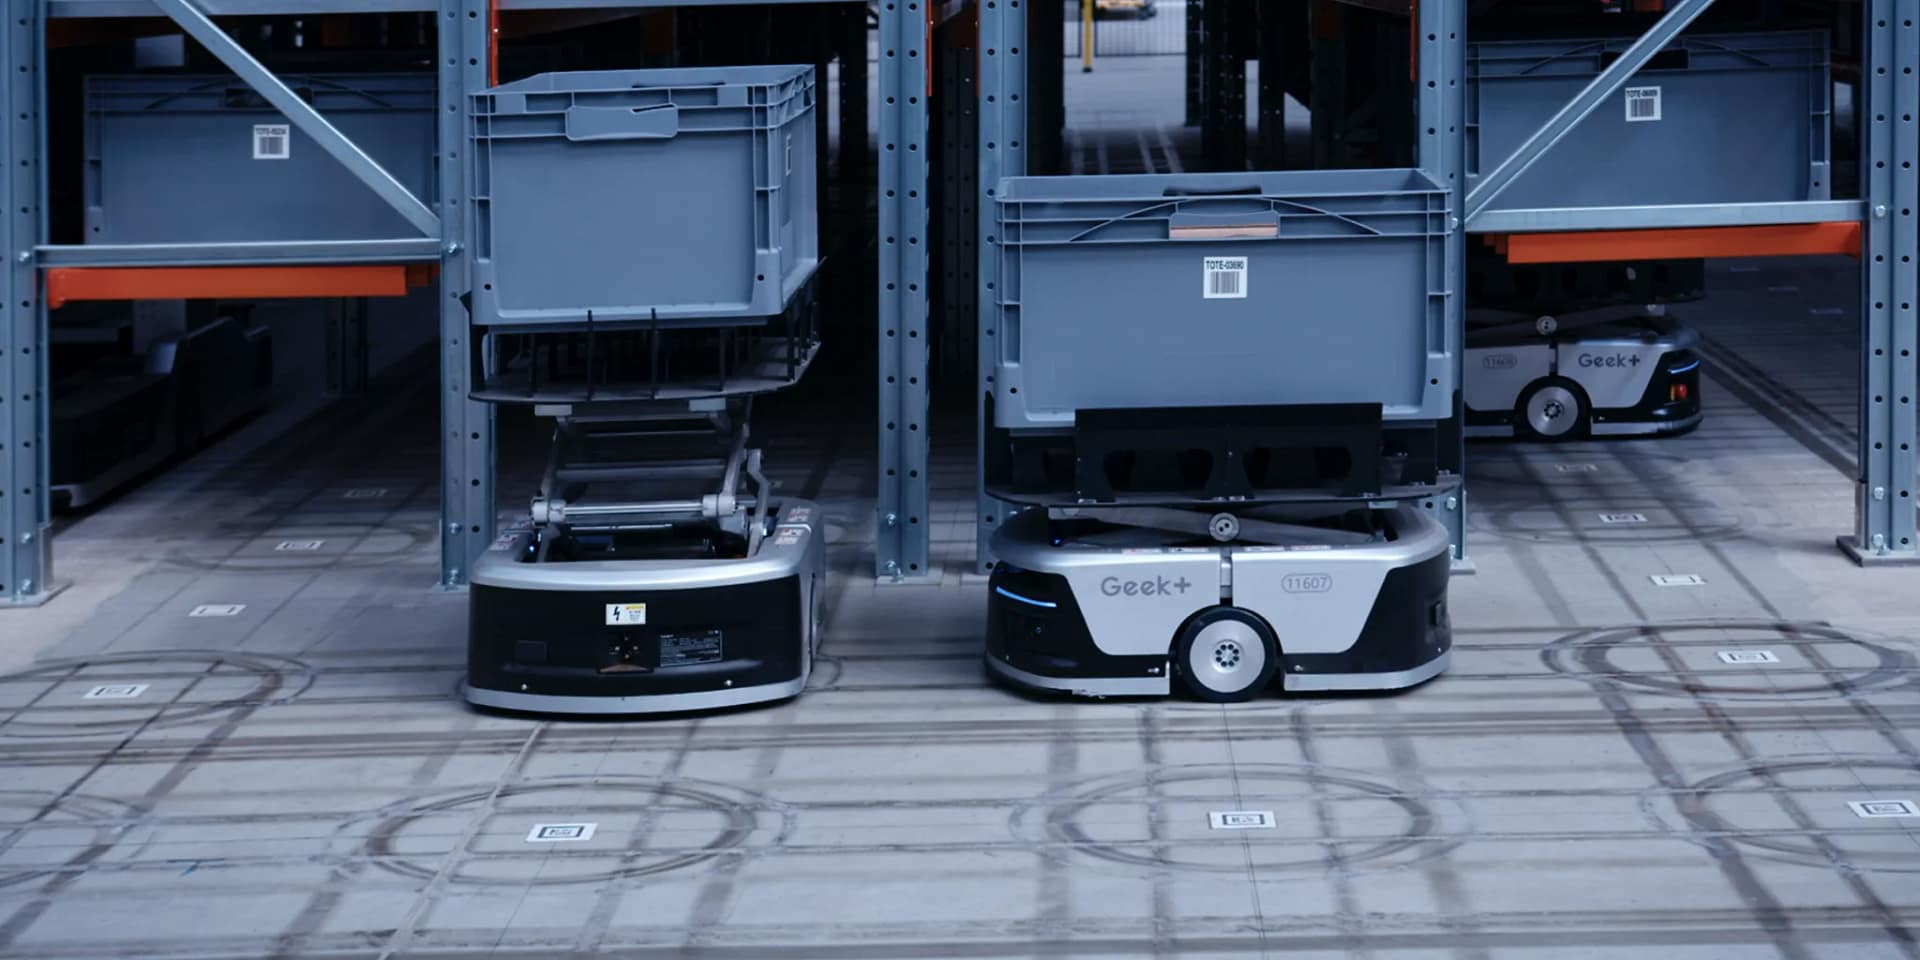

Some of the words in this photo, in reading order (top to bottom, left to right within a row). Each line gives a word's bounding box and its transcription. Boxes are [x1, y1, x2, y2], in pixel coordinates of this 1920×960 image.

[1578, 353, 1641, 368] Geek+
[1100, 575, 1192, 596] Geek+
[1287, 577, 1327, 589] 11607
